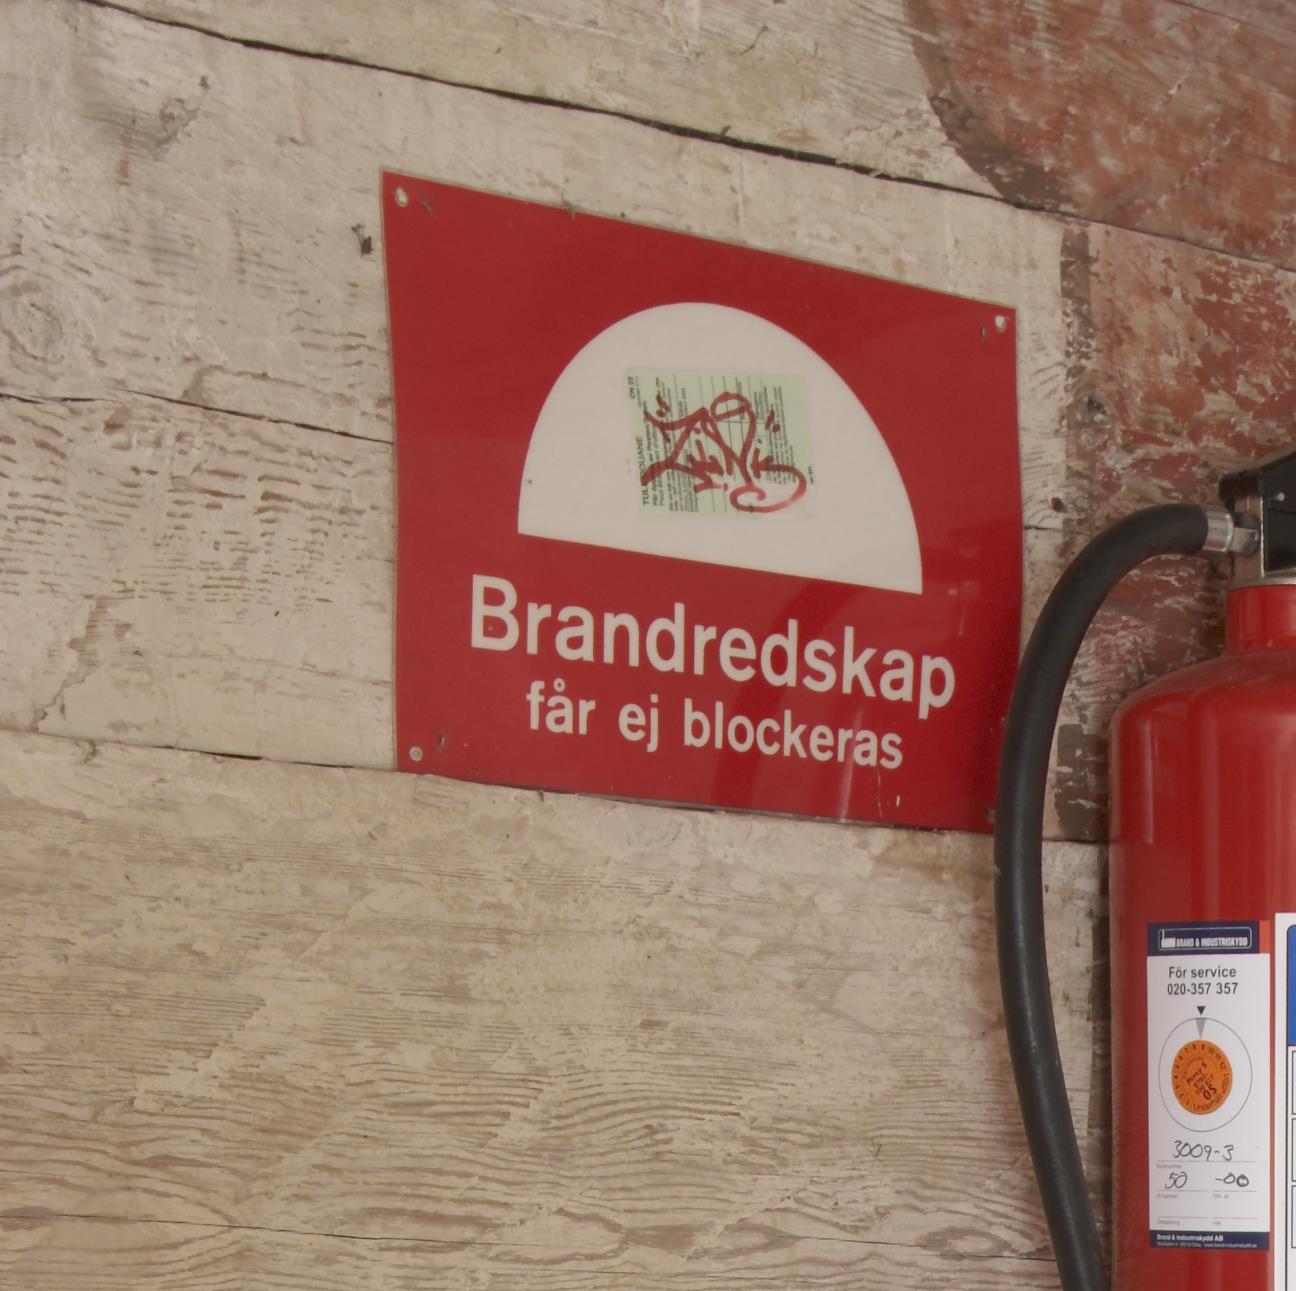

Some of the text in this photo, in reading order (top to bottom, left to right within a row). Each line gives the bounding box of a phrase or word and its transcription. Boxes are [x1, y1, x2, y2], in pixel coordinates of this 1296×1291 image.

[470, 573, 956, 719] Brandredskap
[525, 679, 904, 770] får ej blockeras
[1167, 982, 1238, 995] 020-357 357
[1168, 966, 1236, 978] För service
